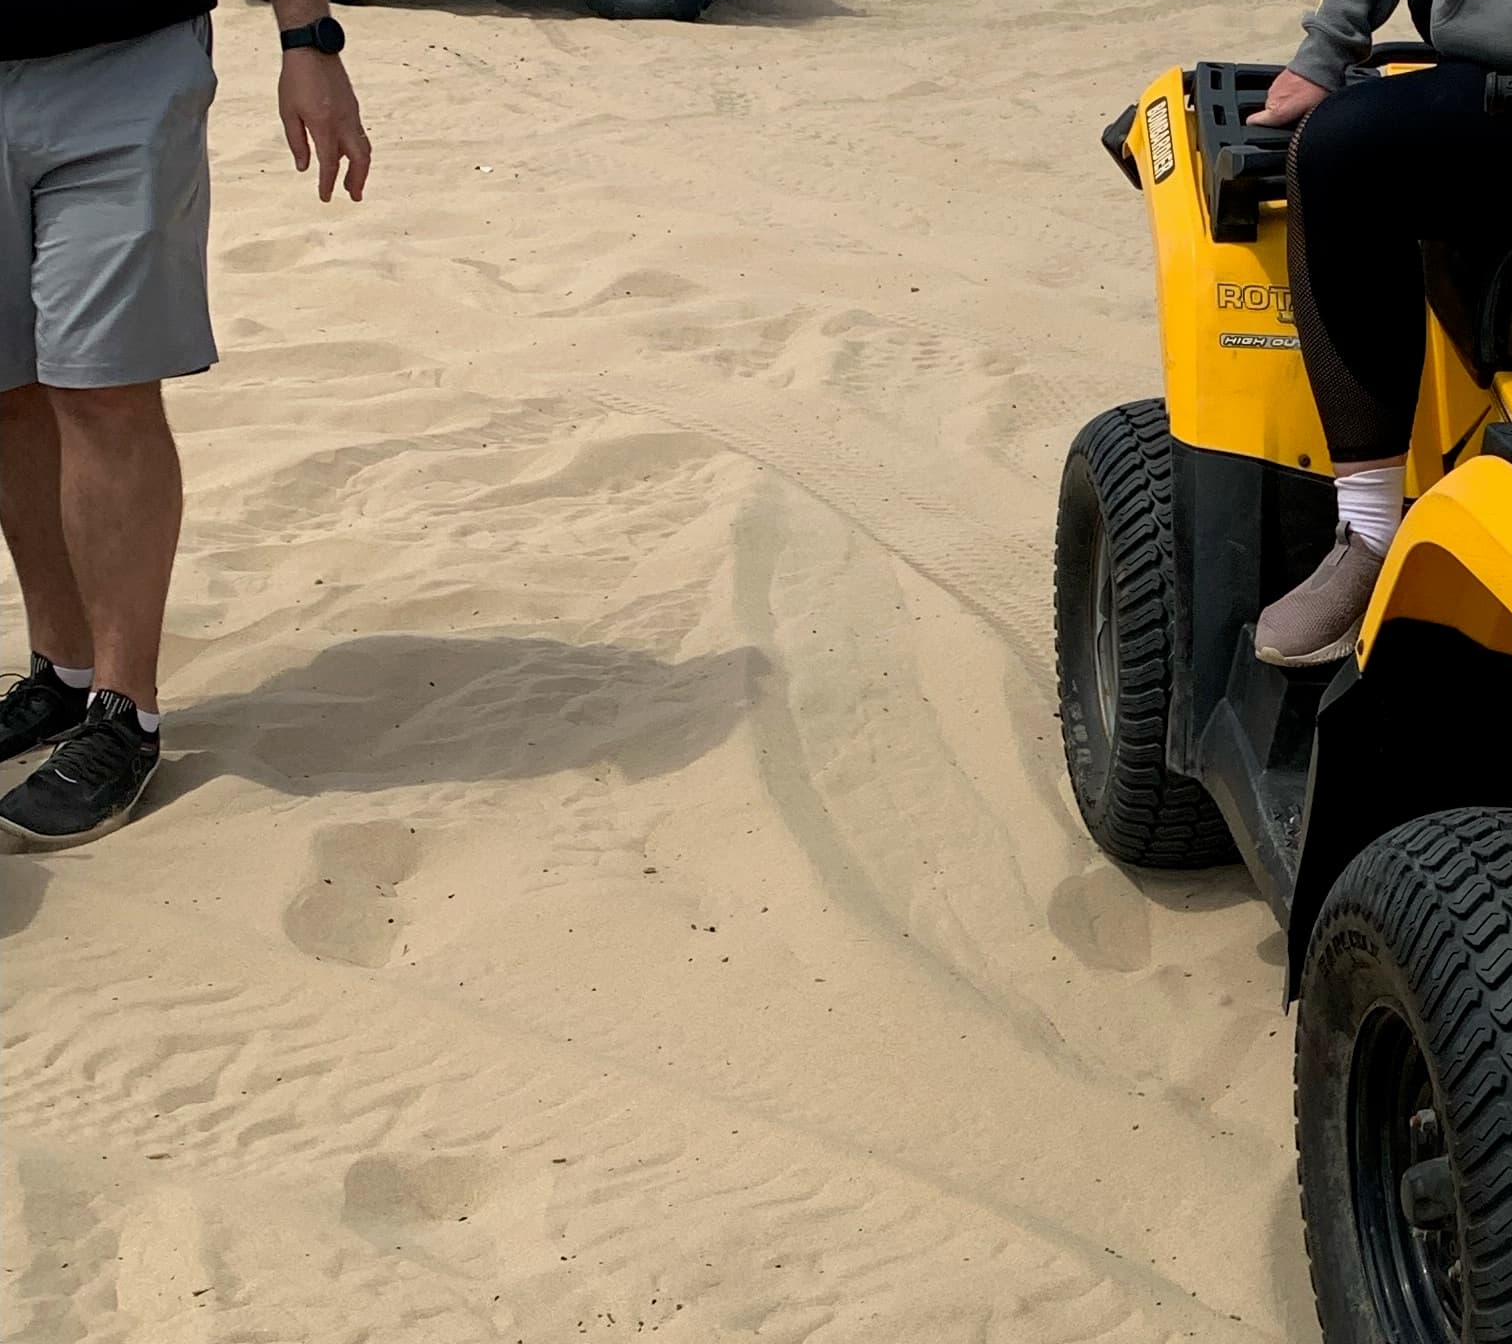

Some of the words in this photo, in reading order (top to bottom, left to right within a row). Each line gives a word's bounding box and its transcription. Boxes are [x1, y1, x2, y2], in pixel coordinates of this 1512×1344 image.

[1146, 99, 1174, 180] BOMBARDIER
[1217, 283, 1294, 311] ROT
[1223, 336, 1266, 347] HIGH
